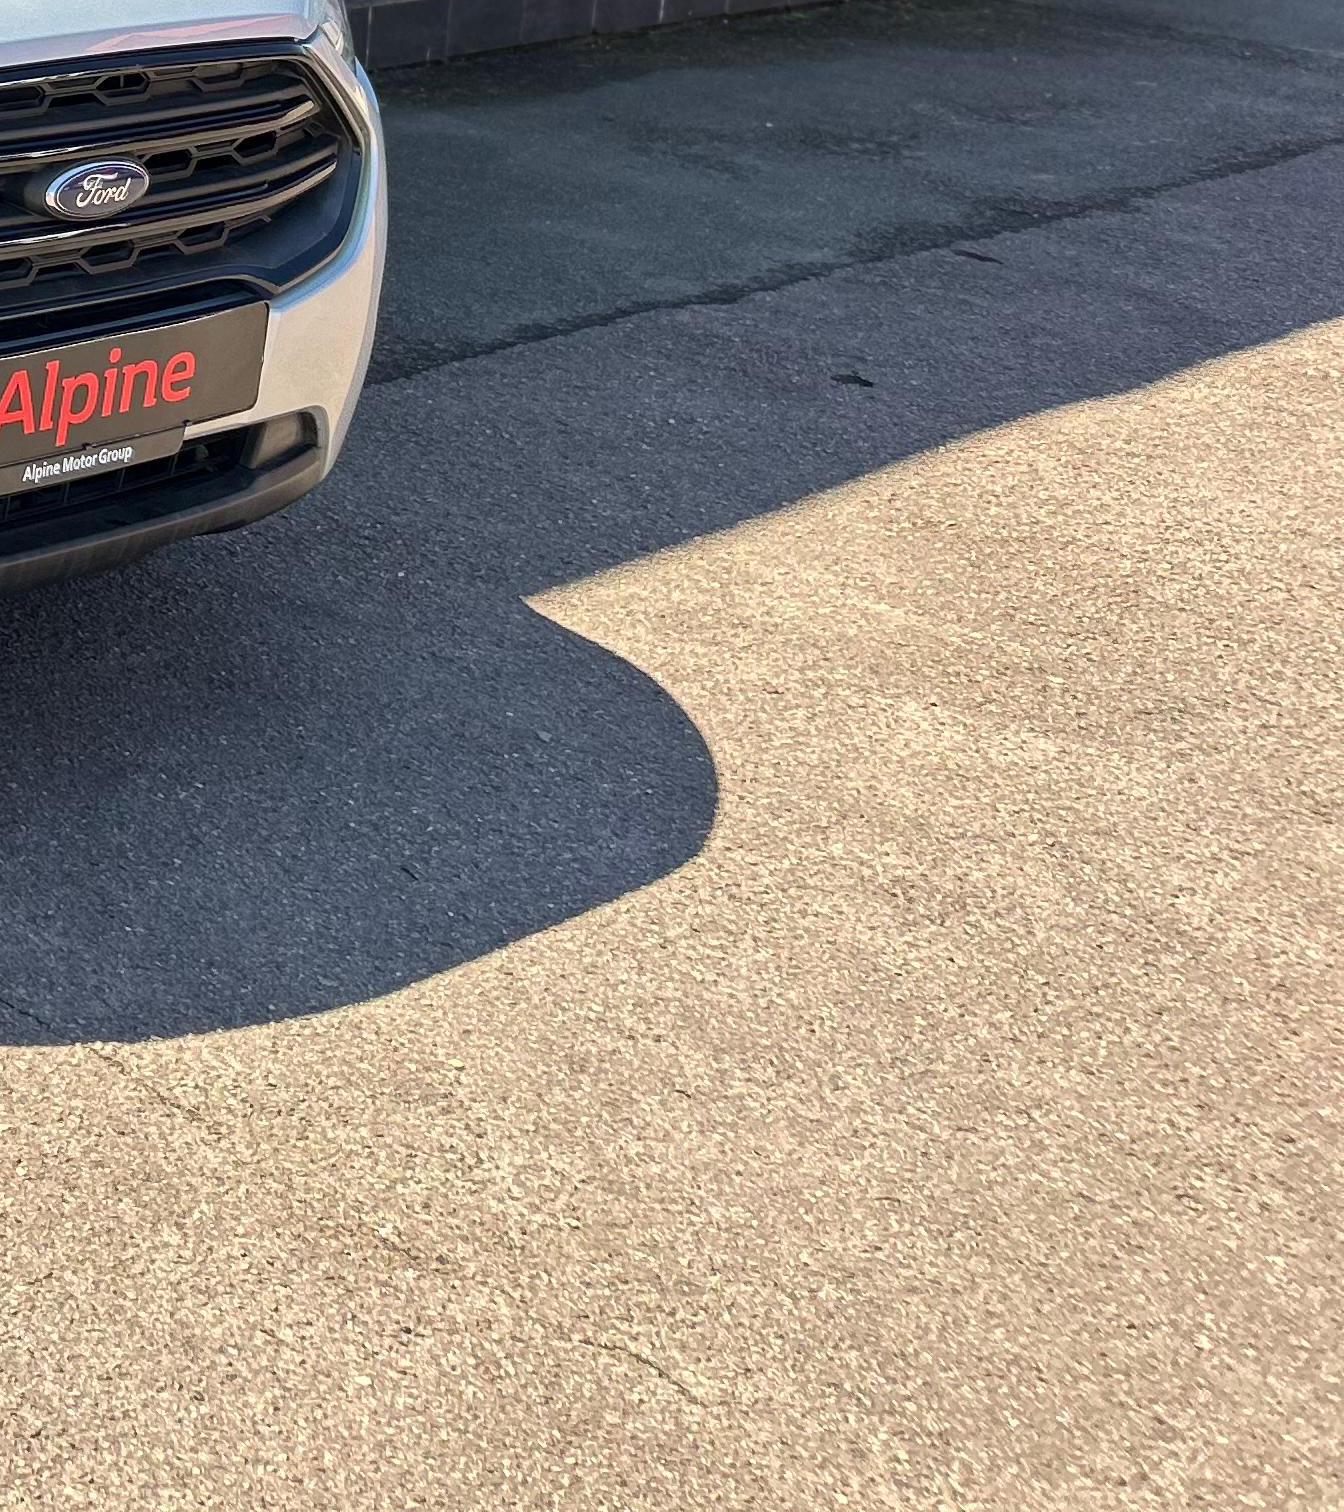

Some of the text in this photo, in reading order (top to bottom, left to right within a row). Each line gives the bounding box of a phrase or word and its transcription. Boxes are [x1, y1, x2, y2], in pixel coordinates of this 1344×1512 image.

[76, 172, 132, 207] Ford
[22, 446, 133, 483] Alpine Motor Group
